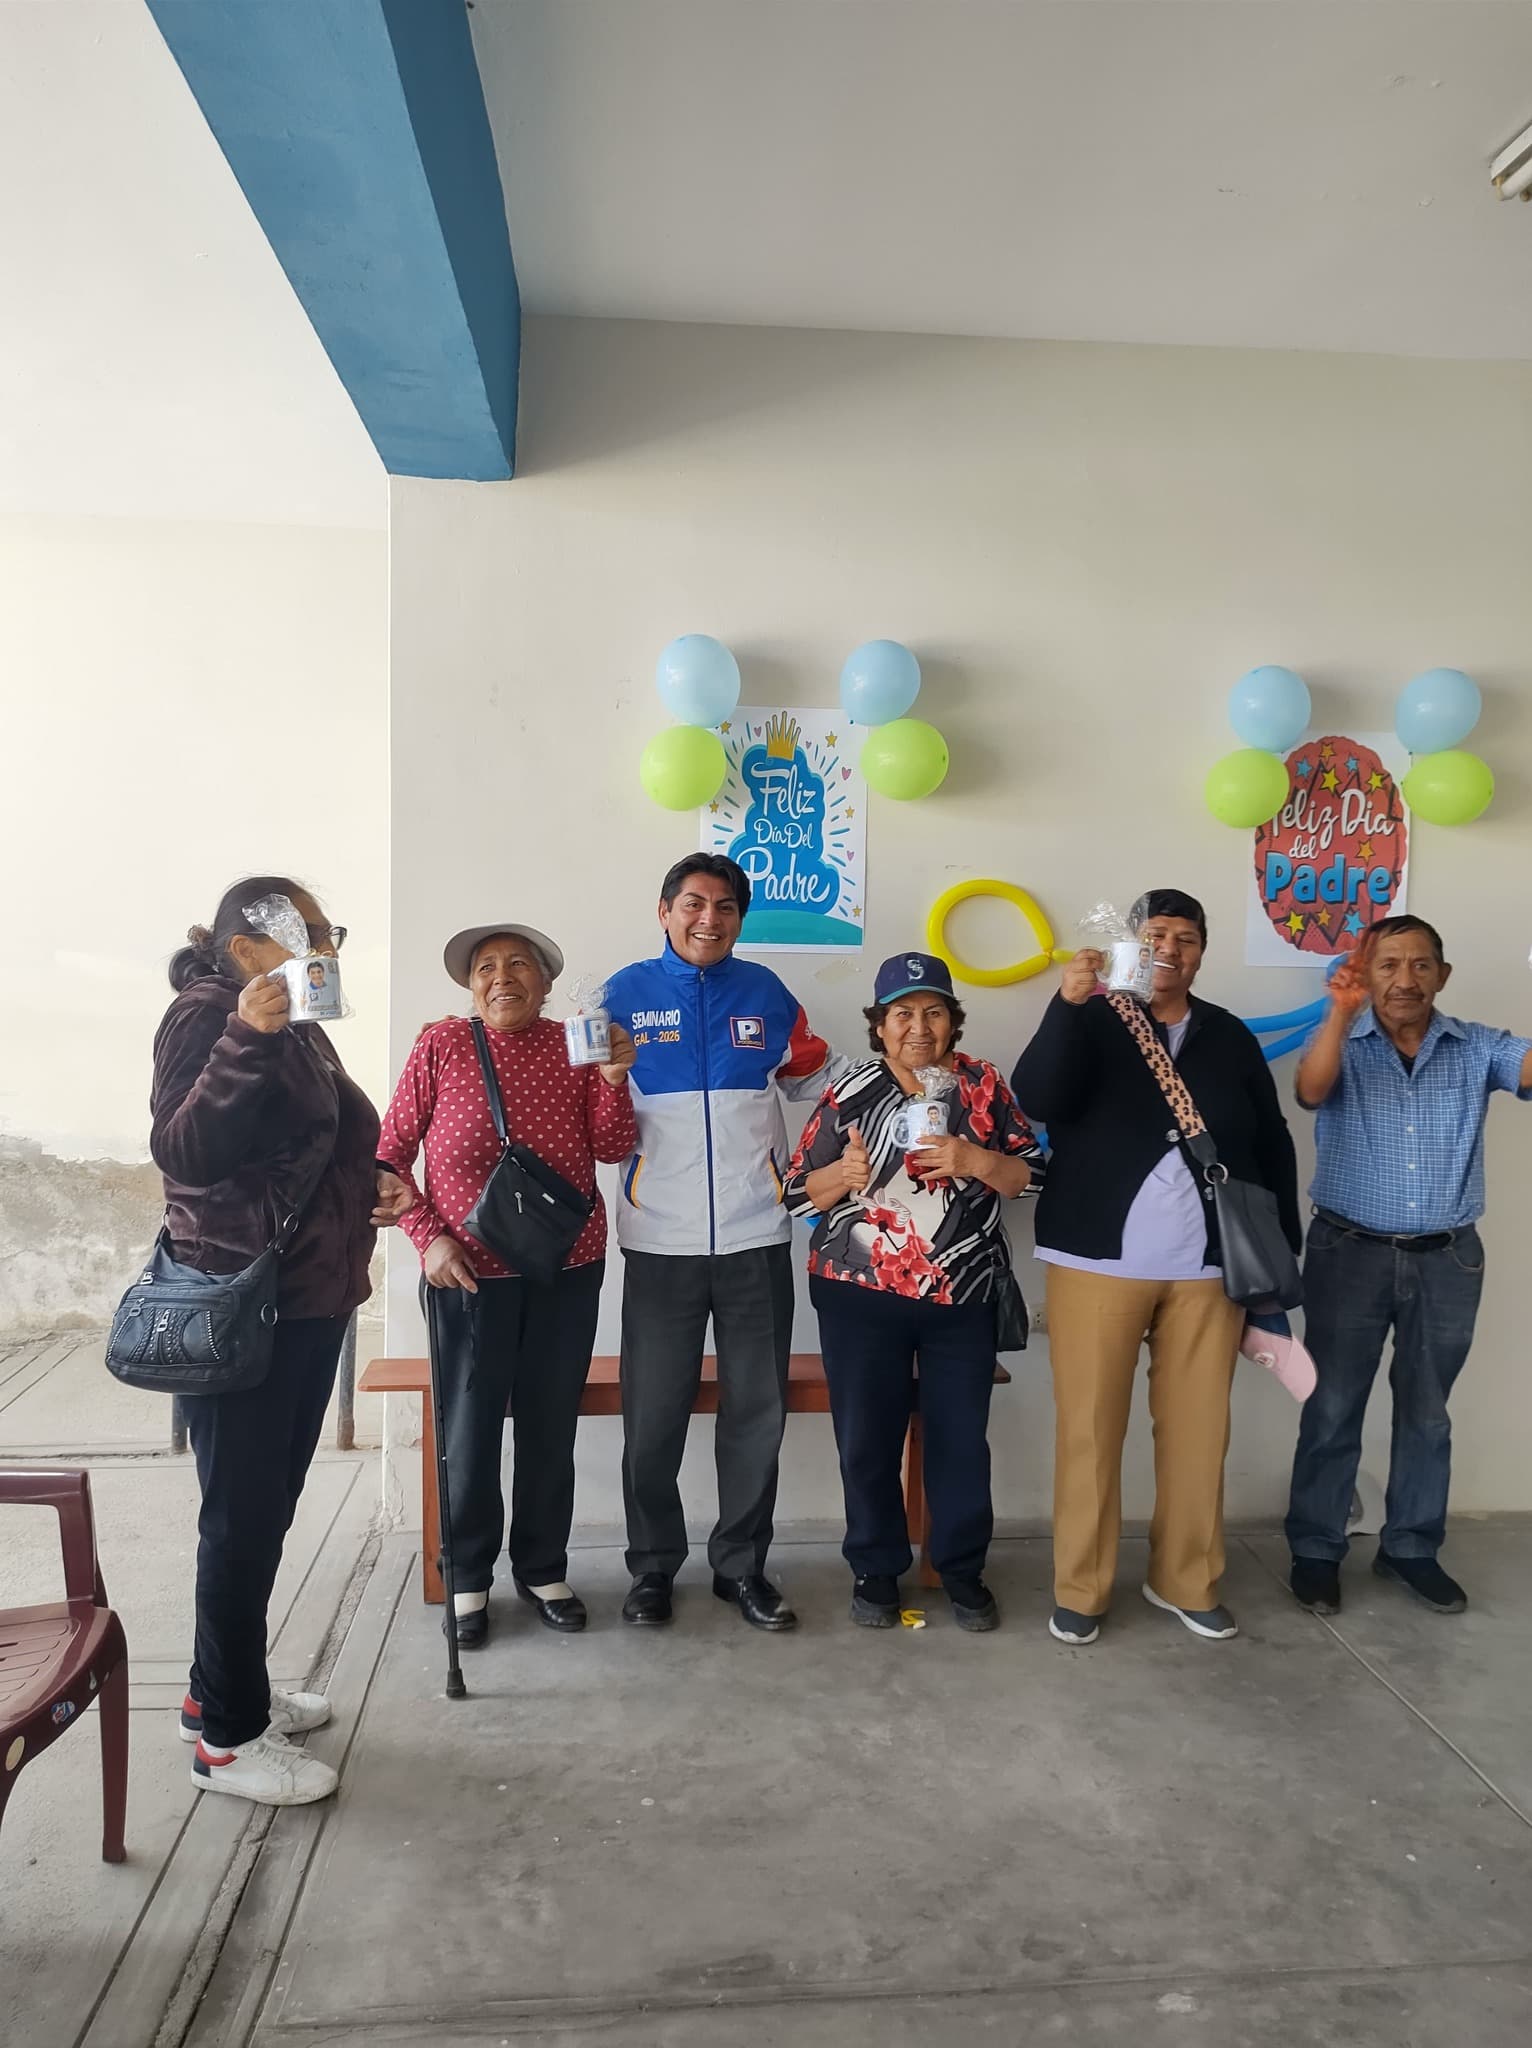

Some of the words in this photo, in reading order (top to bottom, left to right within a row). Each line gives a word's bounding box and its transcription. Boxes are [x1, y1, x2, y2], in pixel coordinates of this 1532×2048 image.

[751, 762, 816, 819] Feliz
[784, 822, 814, 849] Del
[1272, 789, 1339, 850] eliz
[1289, 835, 1319, 859] del
[736, 847, 830, 903] Padre
[1265, 851, 1391, 904] Padre
[631, 1009, 680, 1030] SEMINARIO
[633, 1031, 650, 1047] GAL
